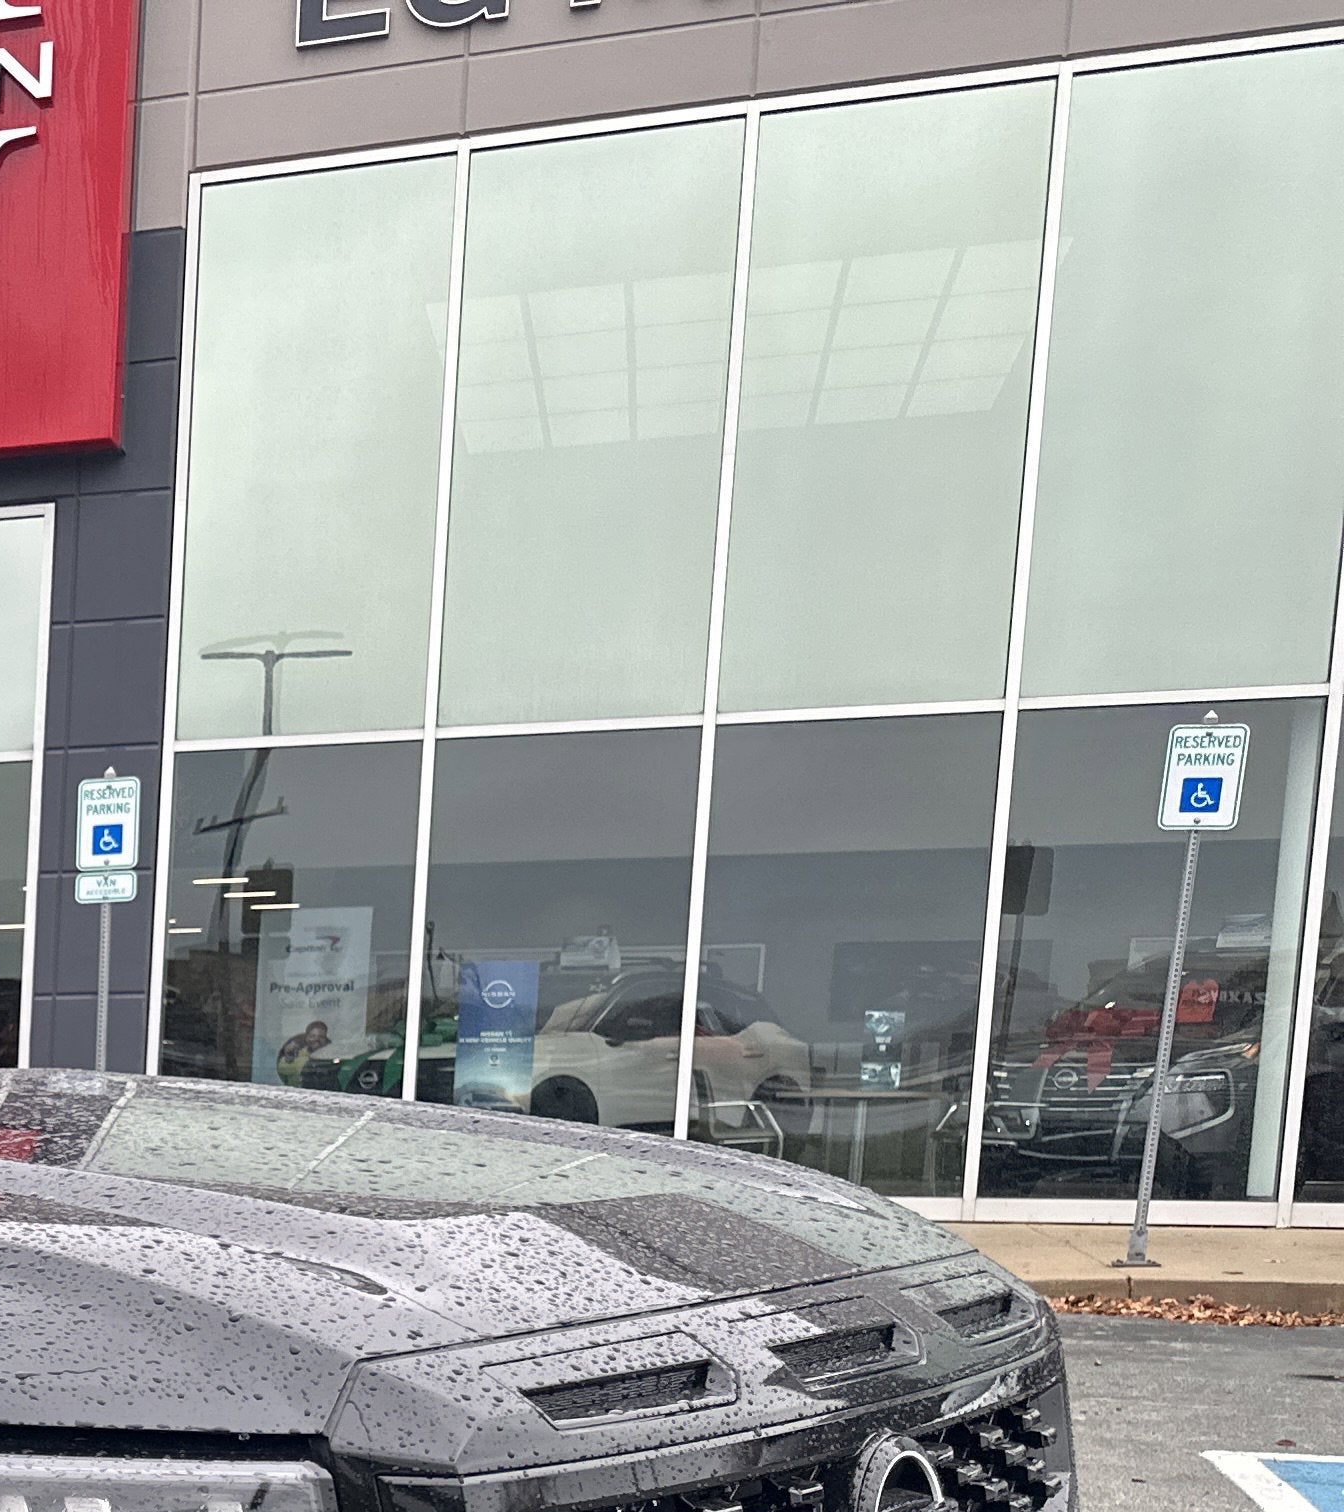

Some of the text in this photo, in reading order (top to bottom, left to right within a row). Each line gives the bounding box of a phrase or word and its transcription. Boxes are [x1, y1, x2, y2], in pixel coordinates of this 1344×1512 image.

[1174, 735, 1242, 749] RESERVED
[1176, 753, 1235, 766] PARKING
[84, 786, 134, 801] RESERVED
[86, 802, 130, 815] PARKING
[96, 879, 116, 888] VAN
[270, 981, 354, 995] Pre-Approval
